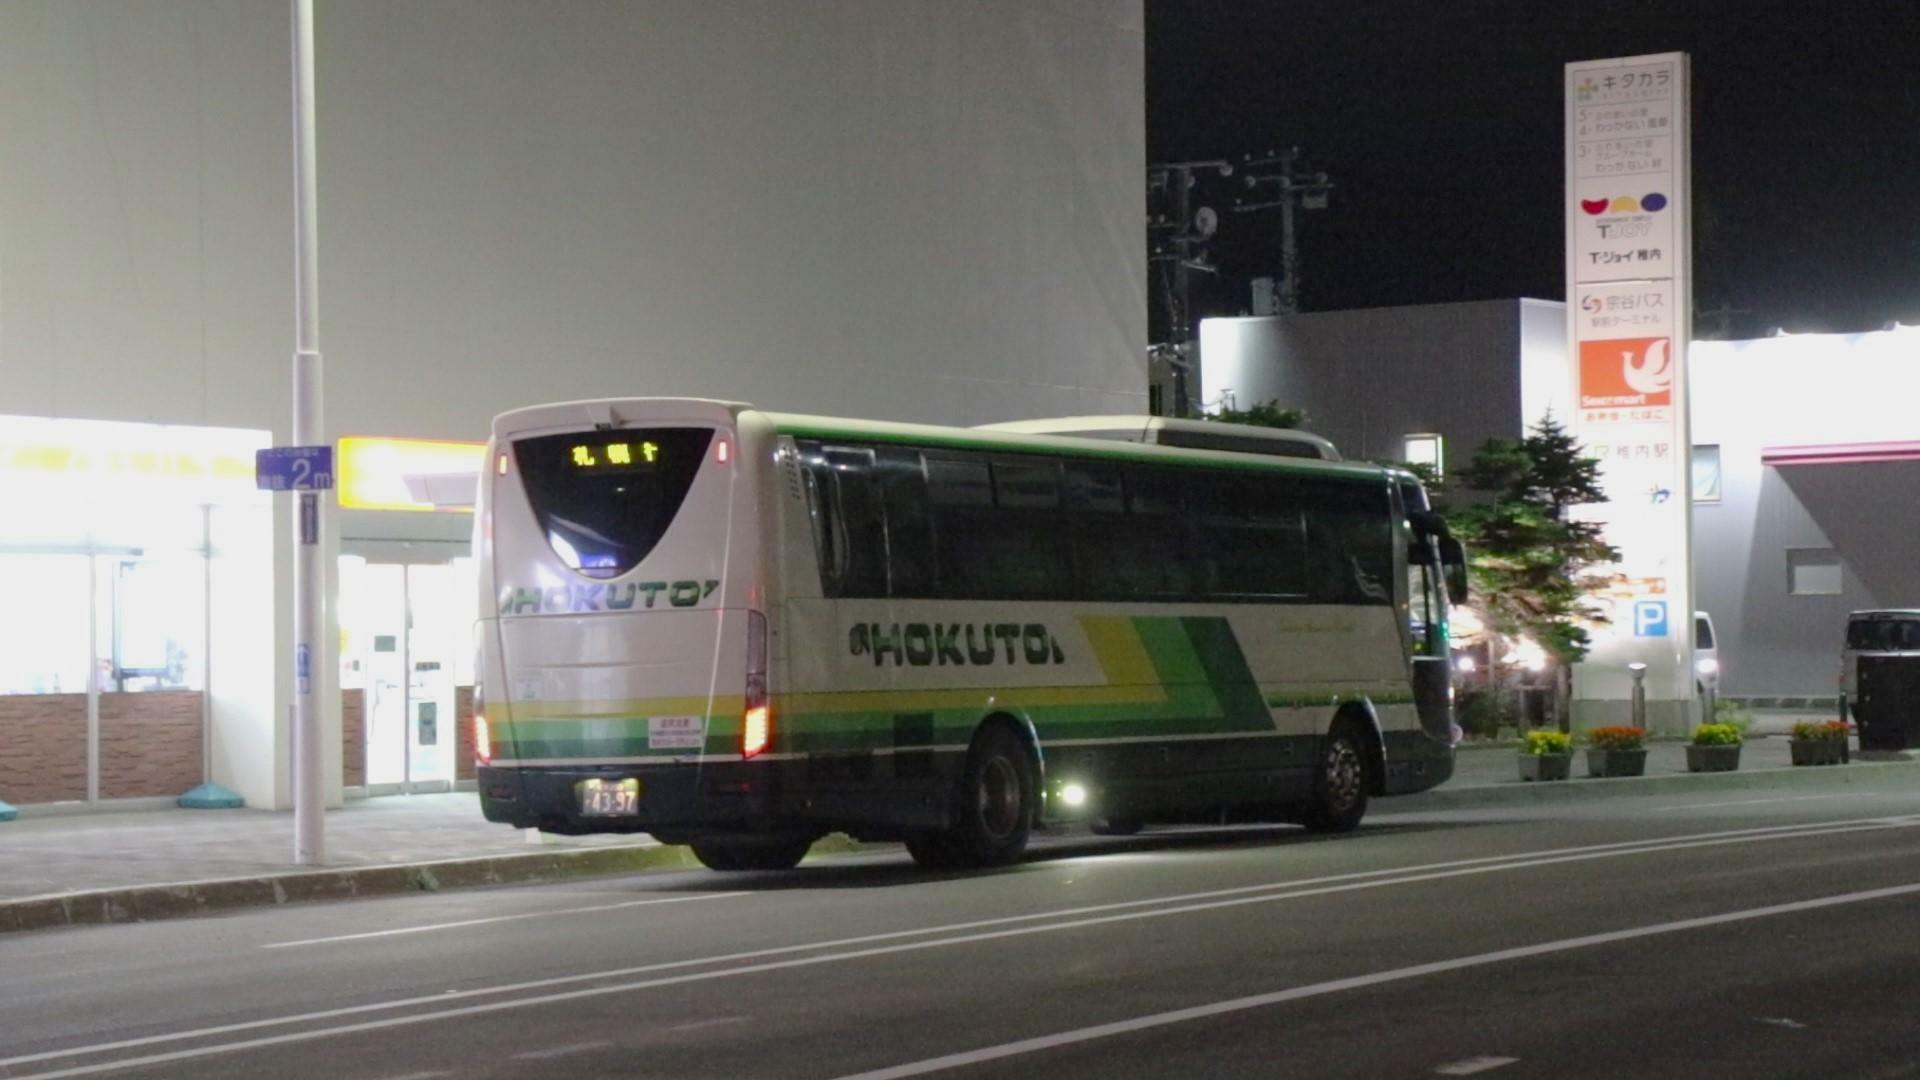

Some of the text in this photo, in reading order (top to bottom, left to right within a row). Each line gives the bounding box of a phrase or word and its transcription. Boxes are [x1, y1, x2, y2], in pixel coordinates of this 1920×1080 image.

[1603, 70, 1670, 89] キタカラ
[1605, 292, 1665, 312] 宗谷バス
[513, 580, 701, 615] HOKUTO
[1638, 603, 1665, 635] P
[871, 622, 1051, 667] HOKUTO
